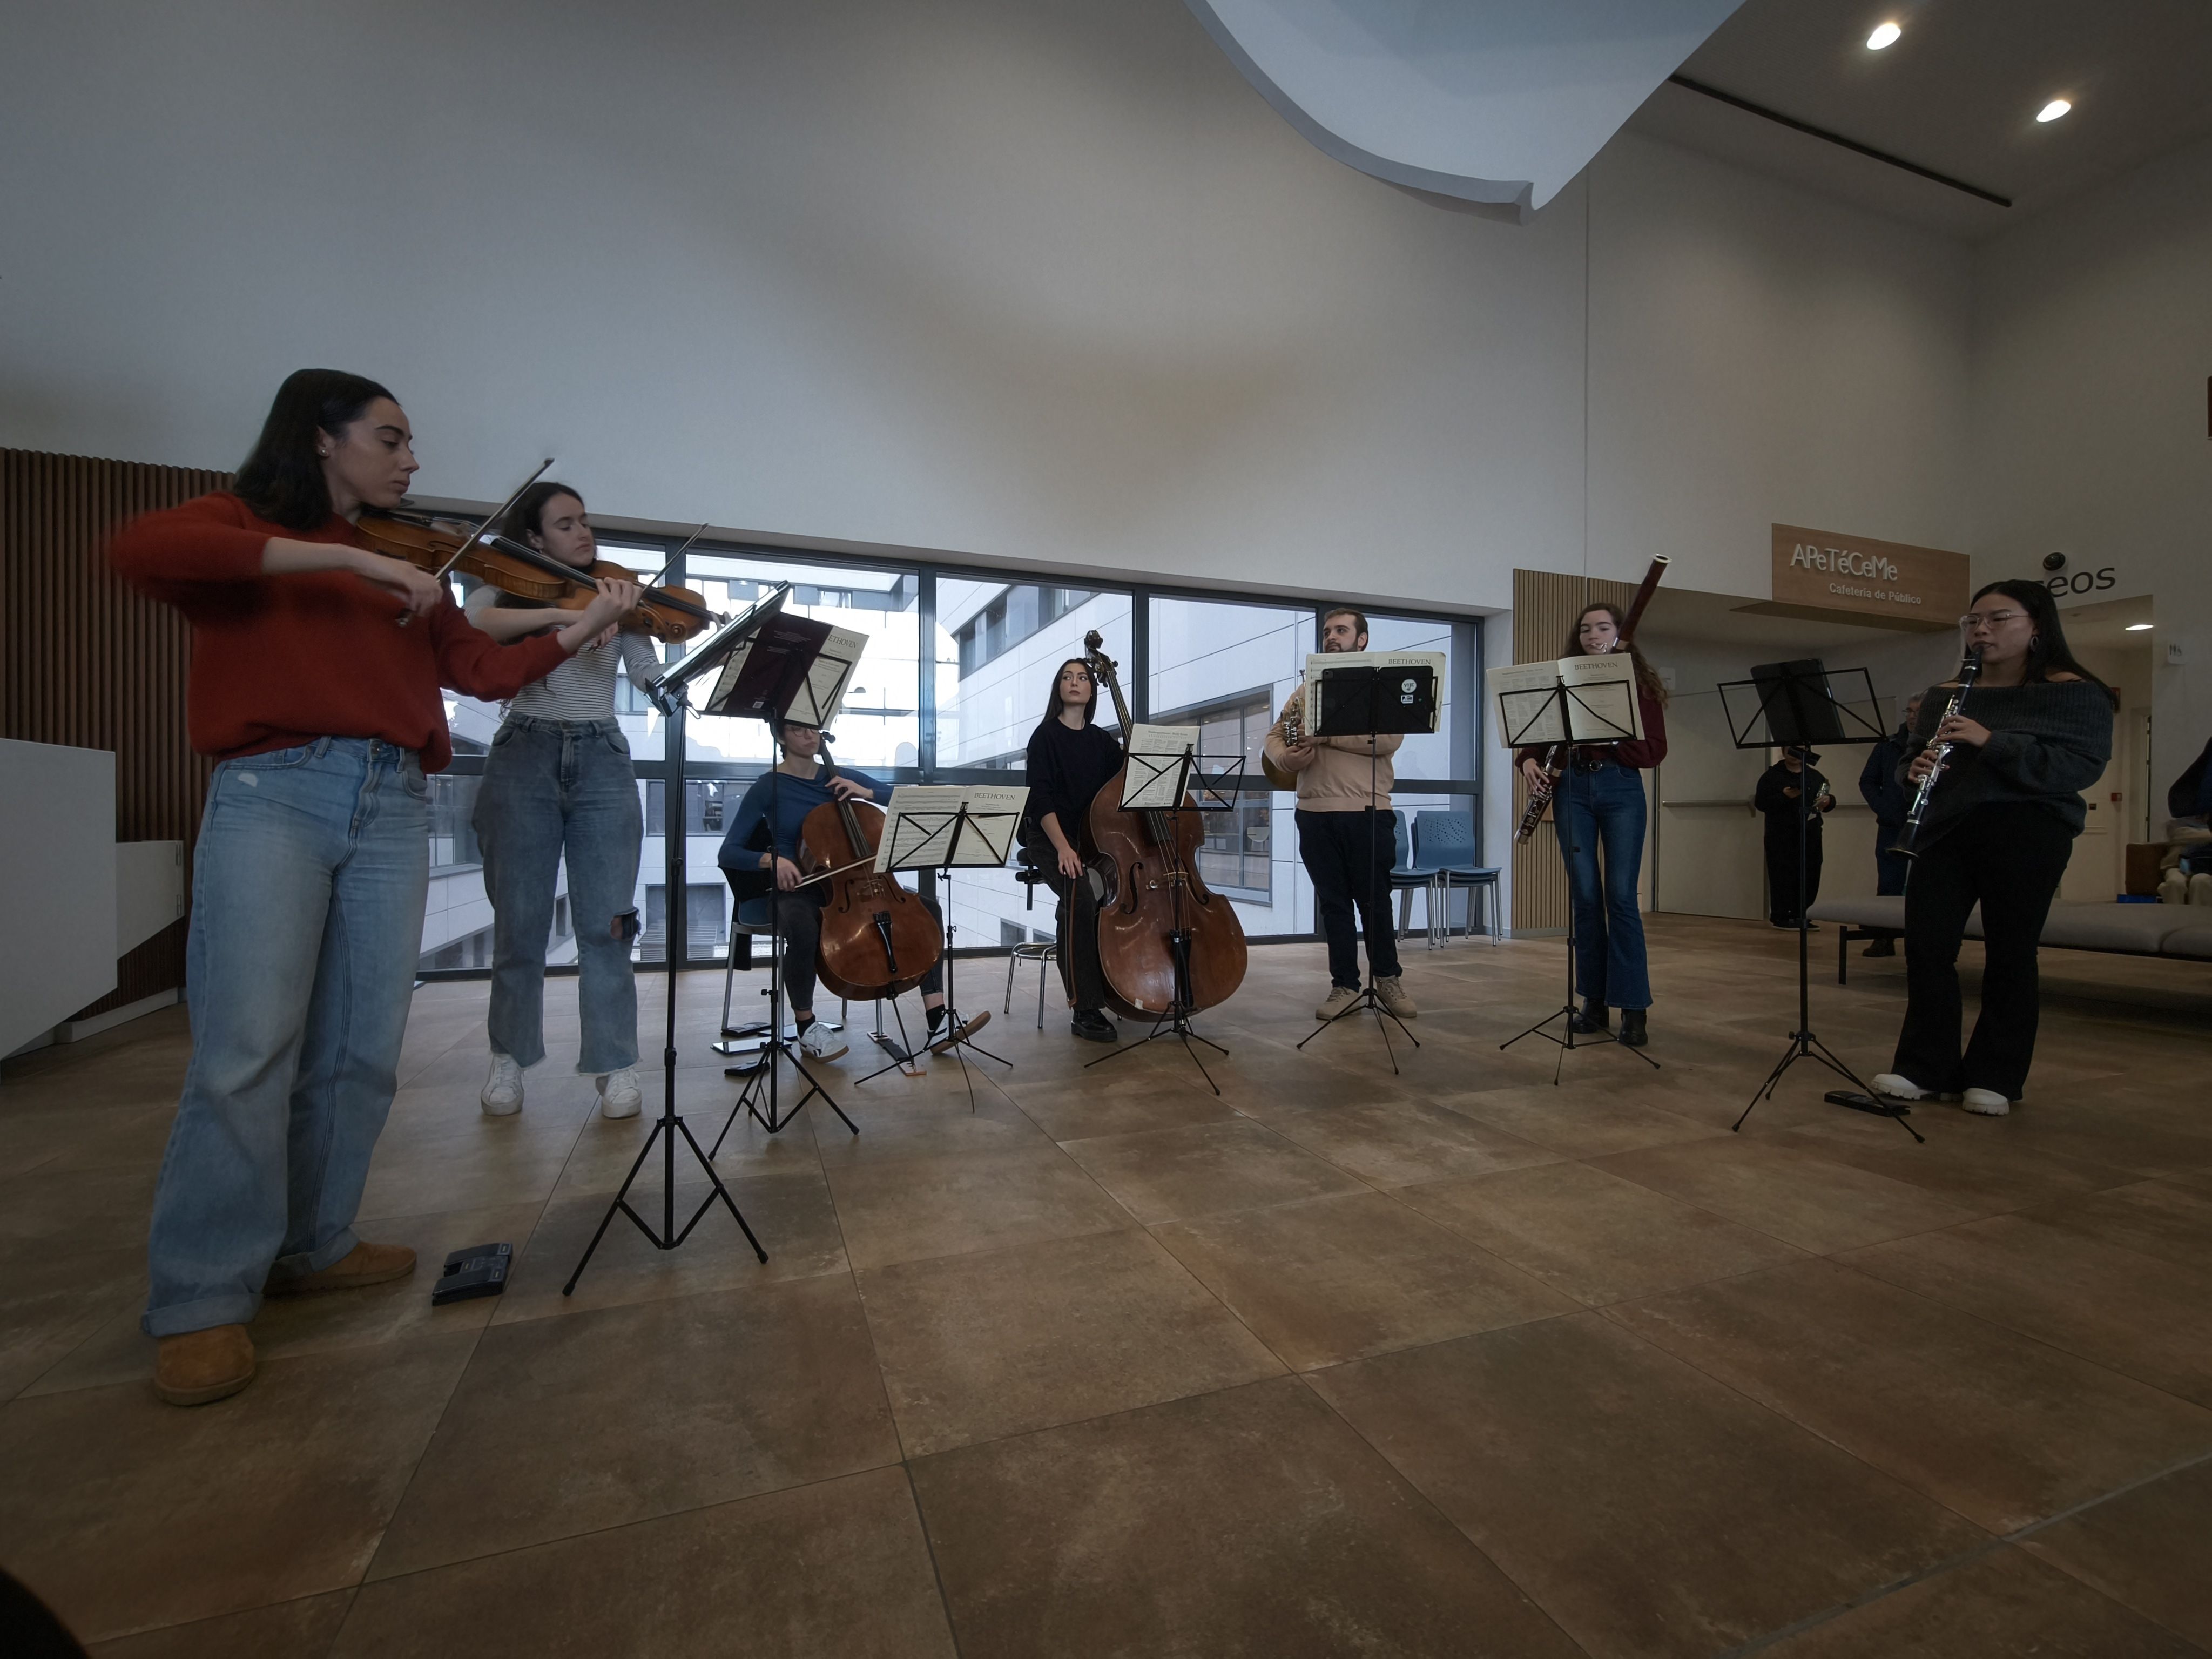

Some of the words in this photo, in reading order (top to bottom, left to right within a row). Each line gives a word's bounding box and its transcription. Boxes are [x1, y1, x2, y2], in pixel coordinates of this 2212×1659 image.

[2042, 567, 2116, 598] eos
[1829, 583, 1872, 598] Cafetería
[1874, 590, 1886, 599] de
[1889, 591, 1921, 604] Público
[828, 635, 859, 648] ETHOVEN
[1575, 662, 1618, 670] BEETHOVEN
